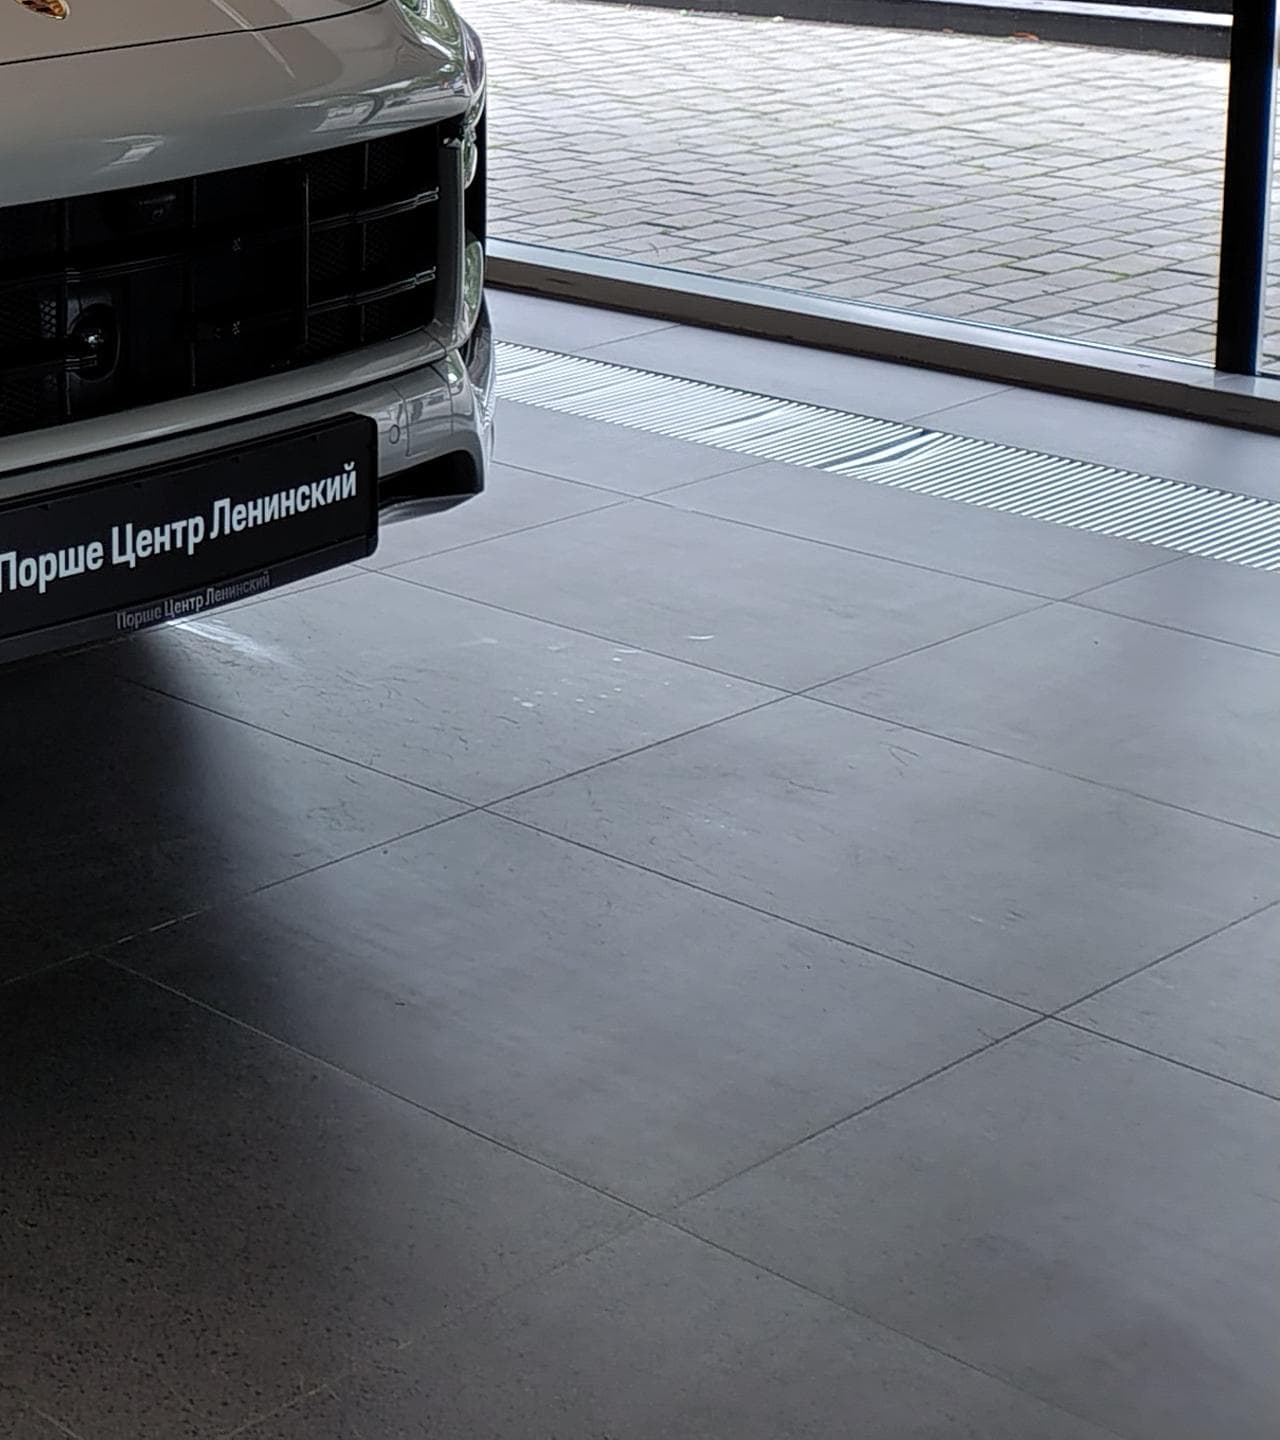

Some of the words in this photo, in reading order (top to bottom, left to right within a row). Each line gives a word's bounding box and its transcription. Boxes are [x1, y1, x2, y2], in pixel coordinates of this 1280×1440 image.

[111, 515, 206, 569] Центр
[209, 461, 357, 540] Ленинский
[115, 610, 162, 630] Порше
[163, 597, 205, 618] Центр
[204, 571, 271, 606] Ленинский
